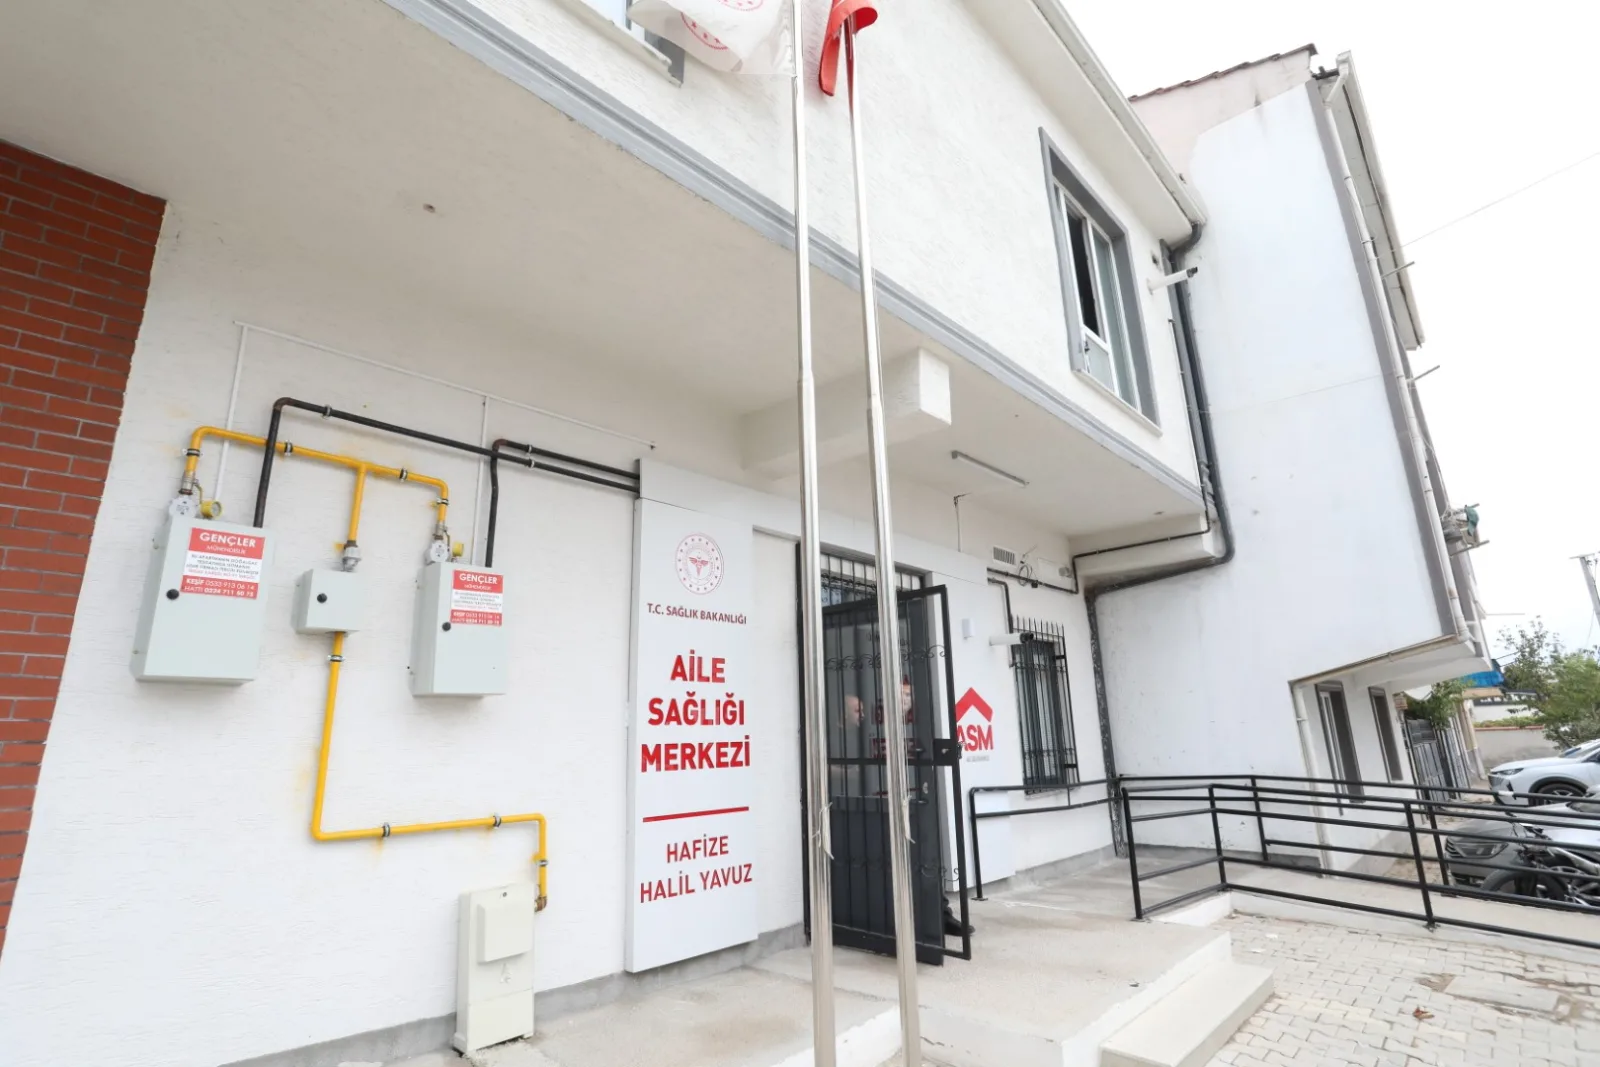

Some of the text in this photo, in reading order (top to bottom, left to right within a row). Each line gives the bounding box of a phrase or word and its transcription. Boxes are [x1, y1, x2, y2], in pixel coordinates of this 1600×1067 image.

[199, 532, 256, 547] GENÇLER
[186, 578, 204, 586] KEŞİF
[459, 573, 498, 584] GENÇLER
[647, 603, 747, 624] T.C. SAĞLIK BAKANLIĞI
[670, 649, 726, 683] AİLE
[648, 691, 745, 726] SAĞLIĞI
[956, 724, 994, 752] ASM
[641, 735, 751, 773] MERKEZİ
[666, 833, 729, 864] HAFİZE
[640, 863, 753, 904] HALİL YAVUZ
